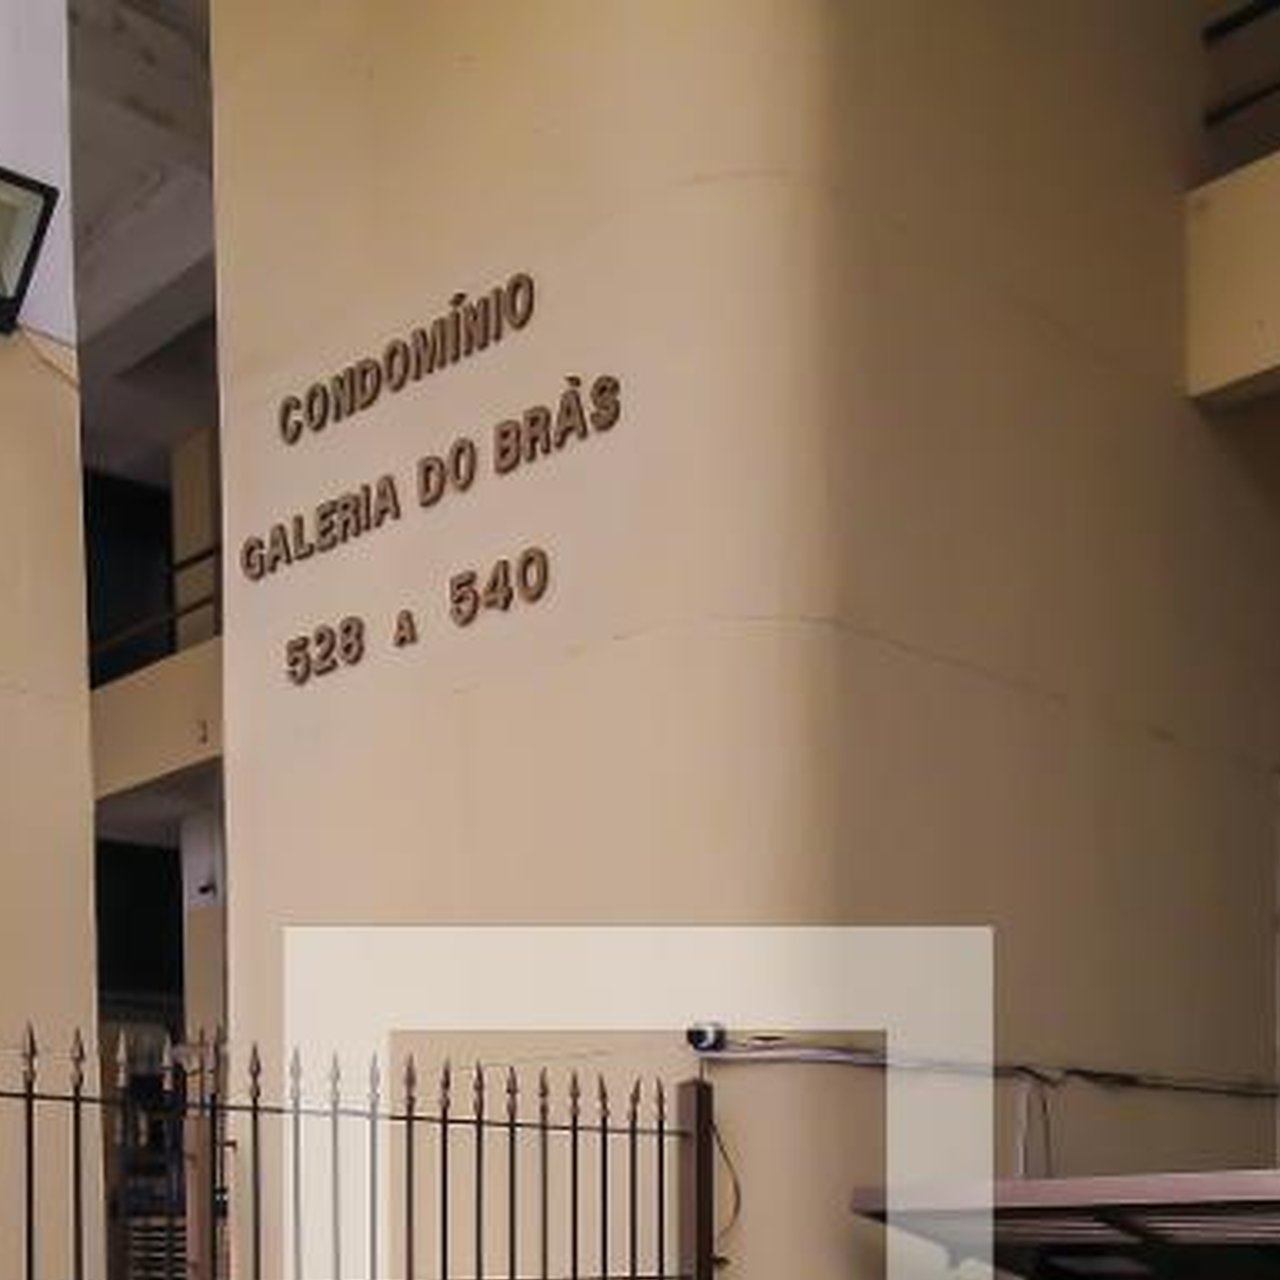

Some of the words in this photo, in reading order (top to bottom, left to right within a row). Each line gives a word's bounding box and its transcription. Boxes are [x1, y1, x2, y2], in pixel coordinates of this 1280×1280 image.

[278, 272, 535, 445] CONDOMÍNIO
[240, 475, 401, 581] GALERIA
[418, 438, 478, 507] DO
[286, 616, 365, 685] 528
[393, 610, 418, 647] A
[449, 546, 548, 628] 540
